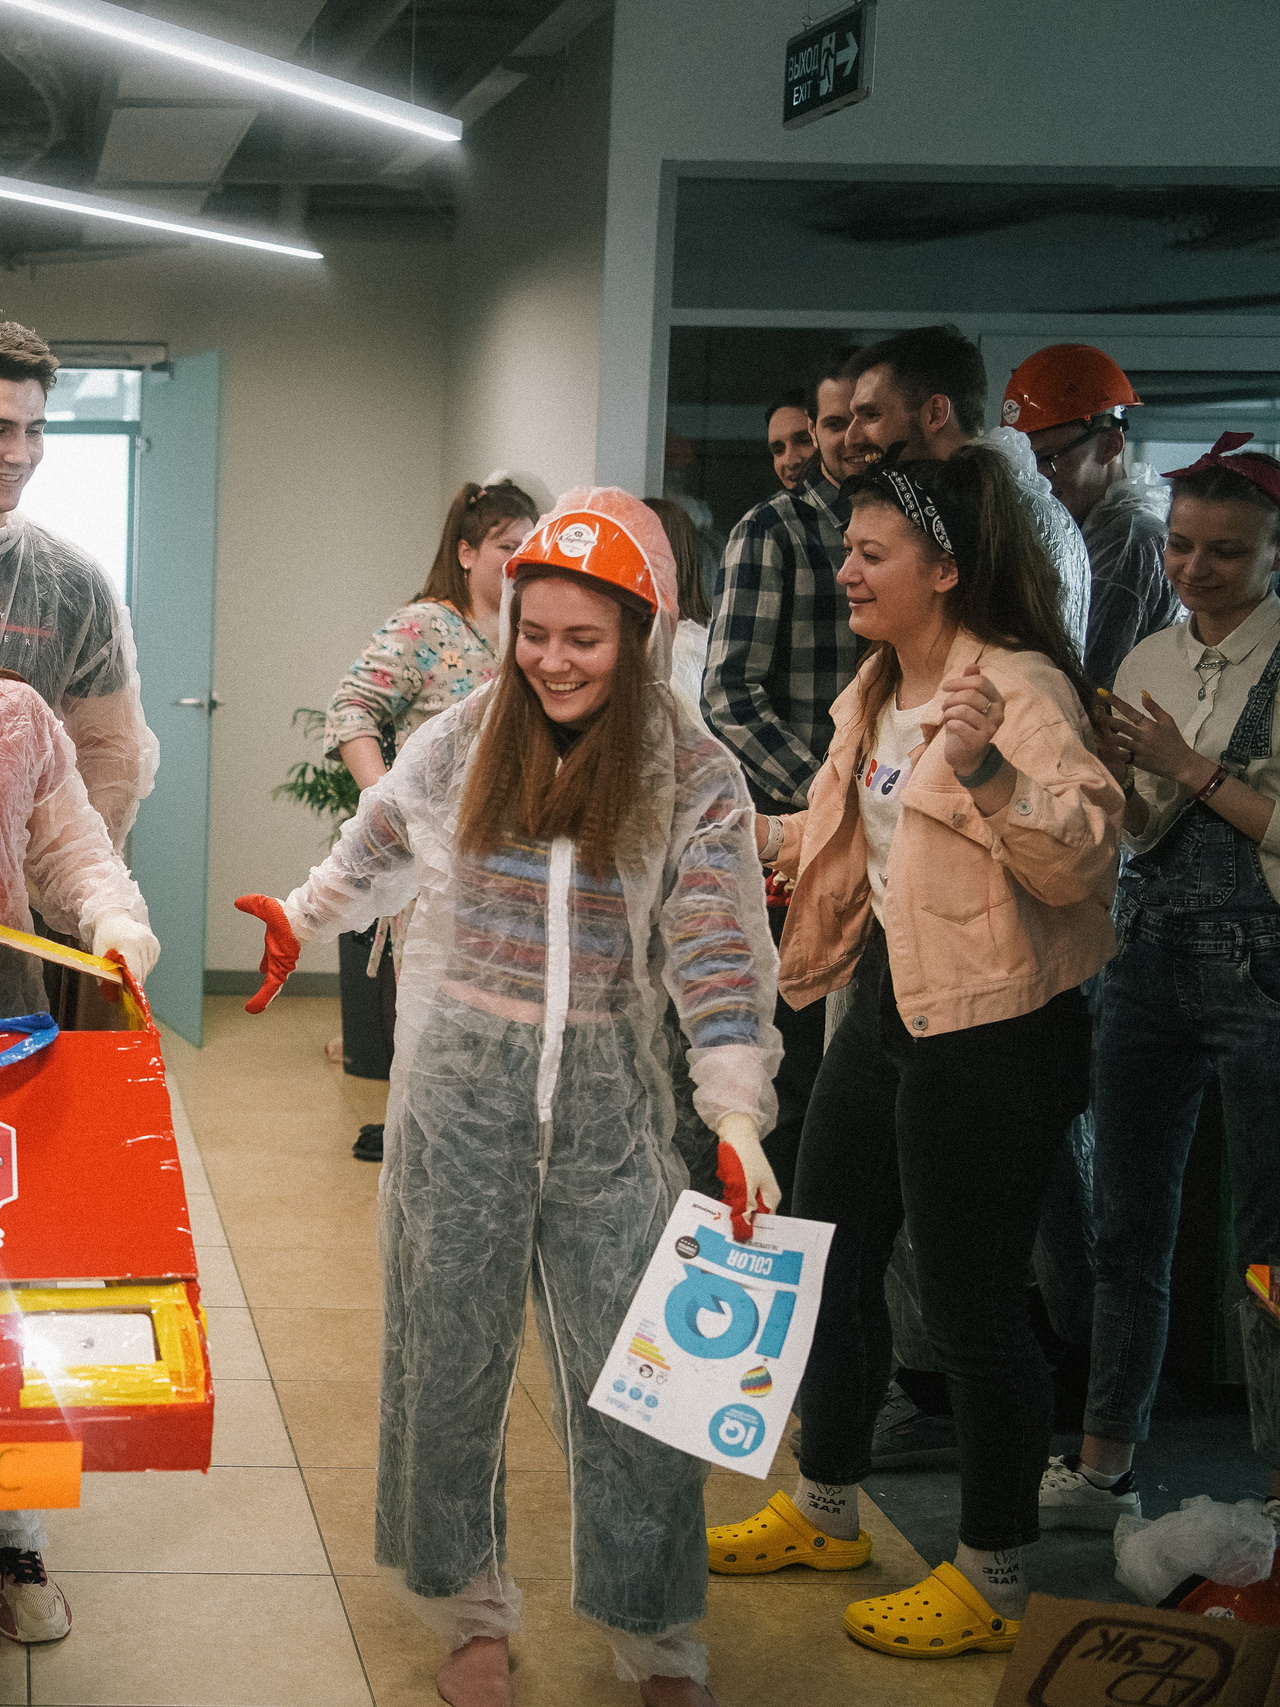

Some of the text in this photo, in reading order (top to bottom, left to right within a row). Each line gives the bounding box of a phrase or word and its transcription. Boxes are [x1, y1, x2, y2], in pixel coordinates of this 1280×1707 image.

[787, 44, 819, 81] ВЫХОД
[793, 81, 812, 105] EXIT
[726, 1248, 773, 1276] COLOR
[664, 1263, 797, 1360] IQ
[719, 1416, 757, 1450] IQ
